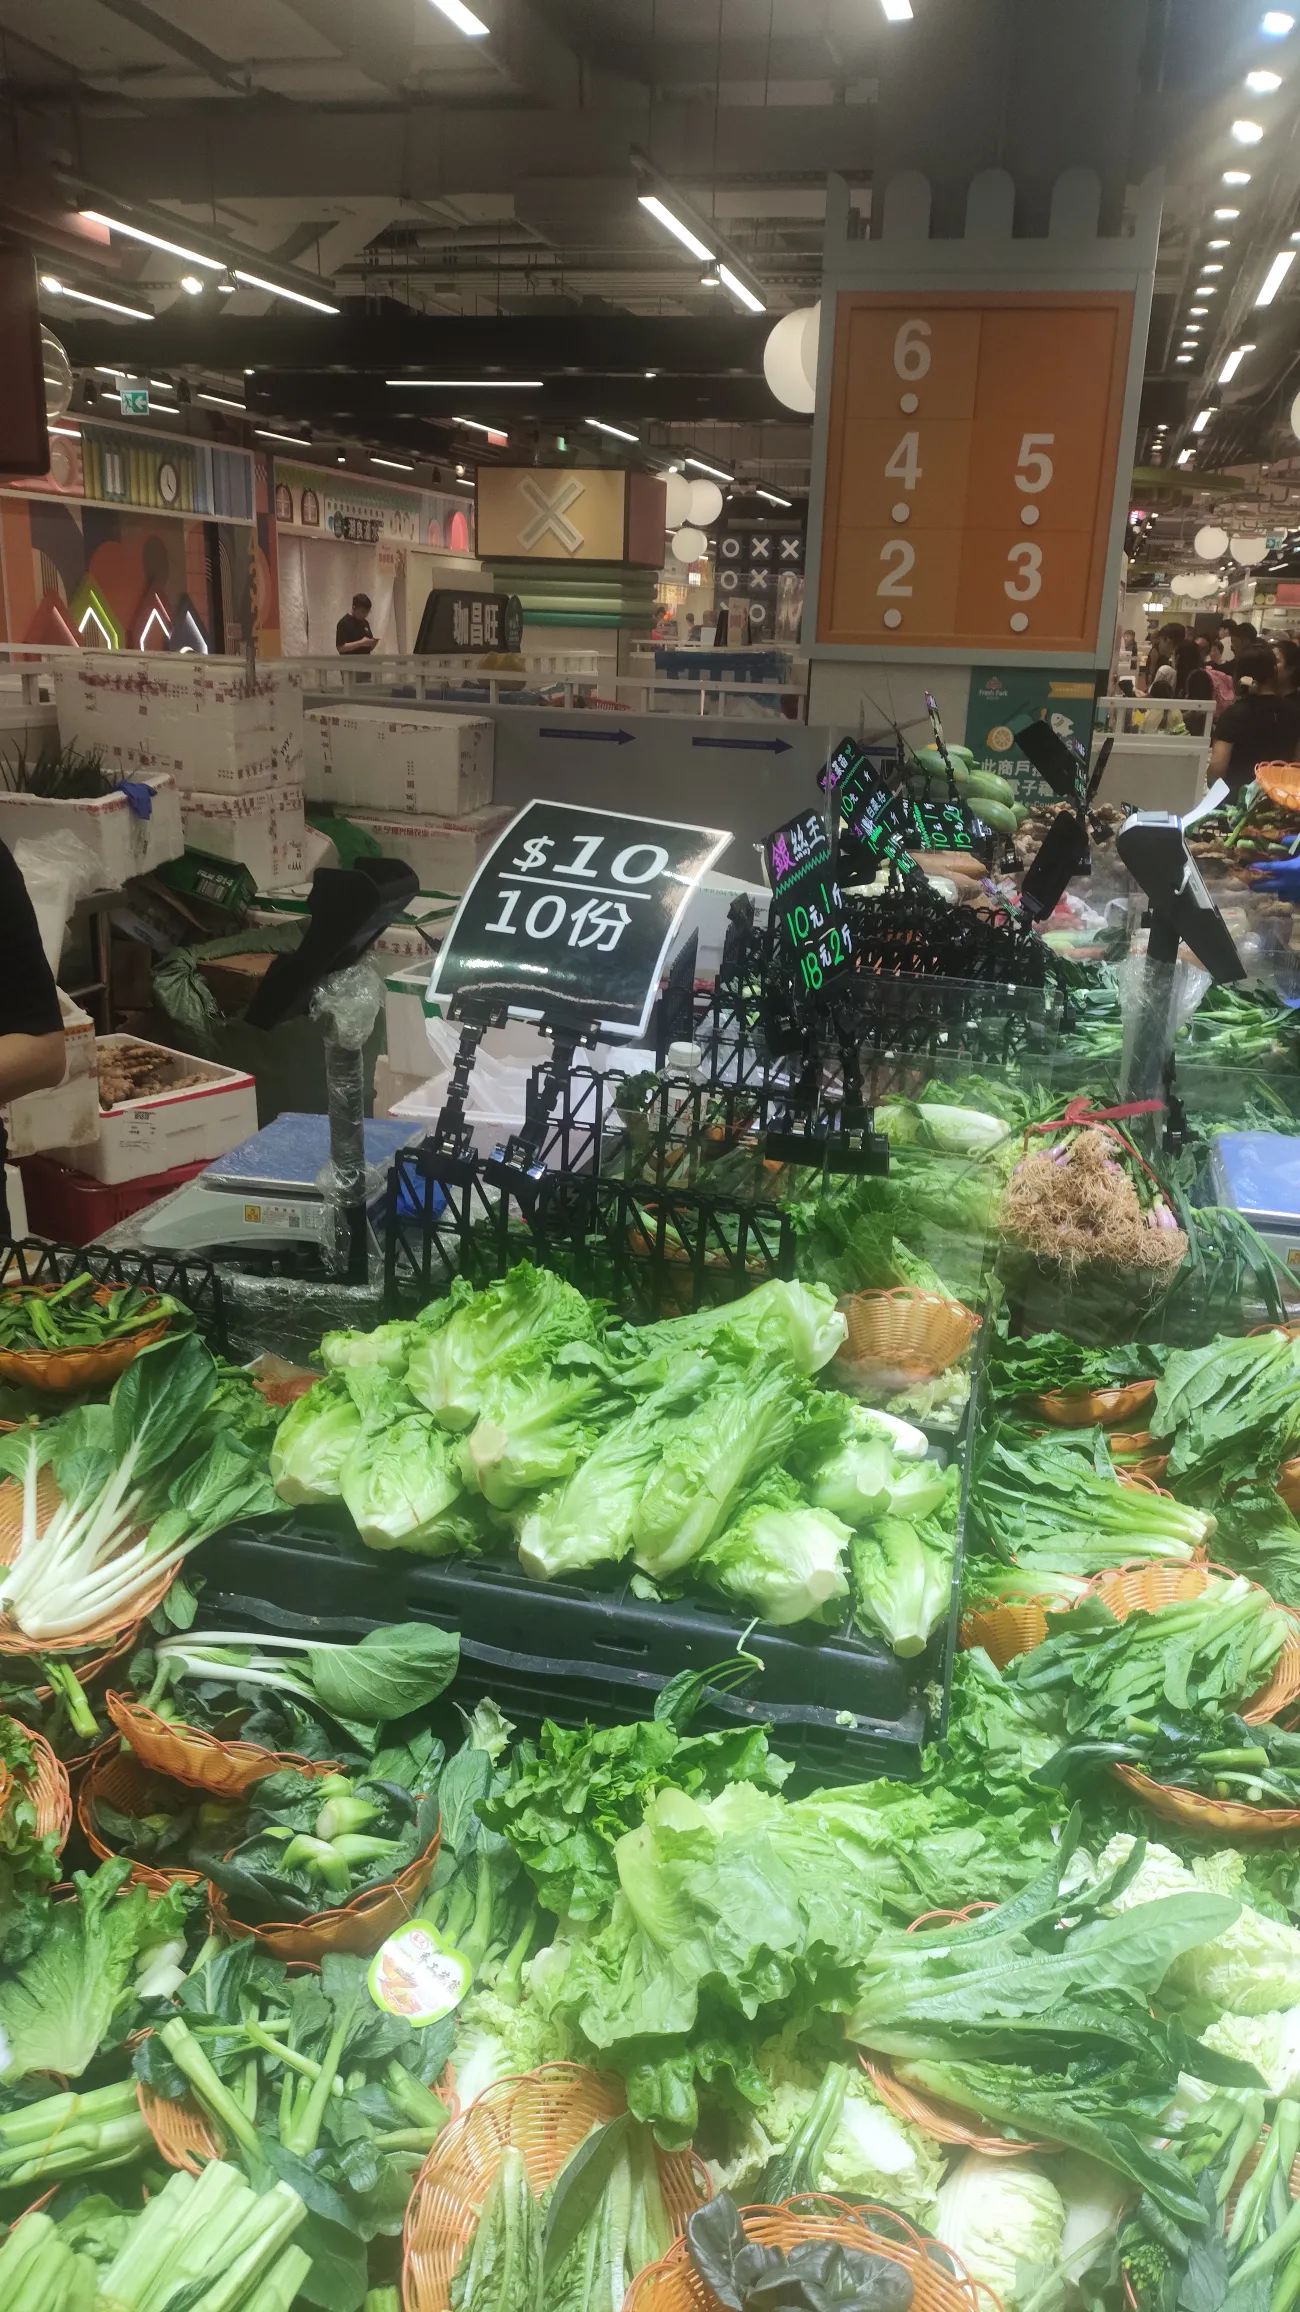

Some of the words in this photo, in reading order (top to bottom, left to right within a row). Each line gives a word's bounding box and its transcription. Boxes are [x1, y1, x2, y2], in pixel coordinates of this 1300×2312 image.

[893, 318, 932, 382] 6
[884, 431, 922, 491] 4
[1014, 432, 1055, 494] 5
[876, 539, 916, 598] 2
[1003, 541, 1043, 601] 3
[512, 835, 669, 884] $10
[485, 890, 632, 951] 10份
